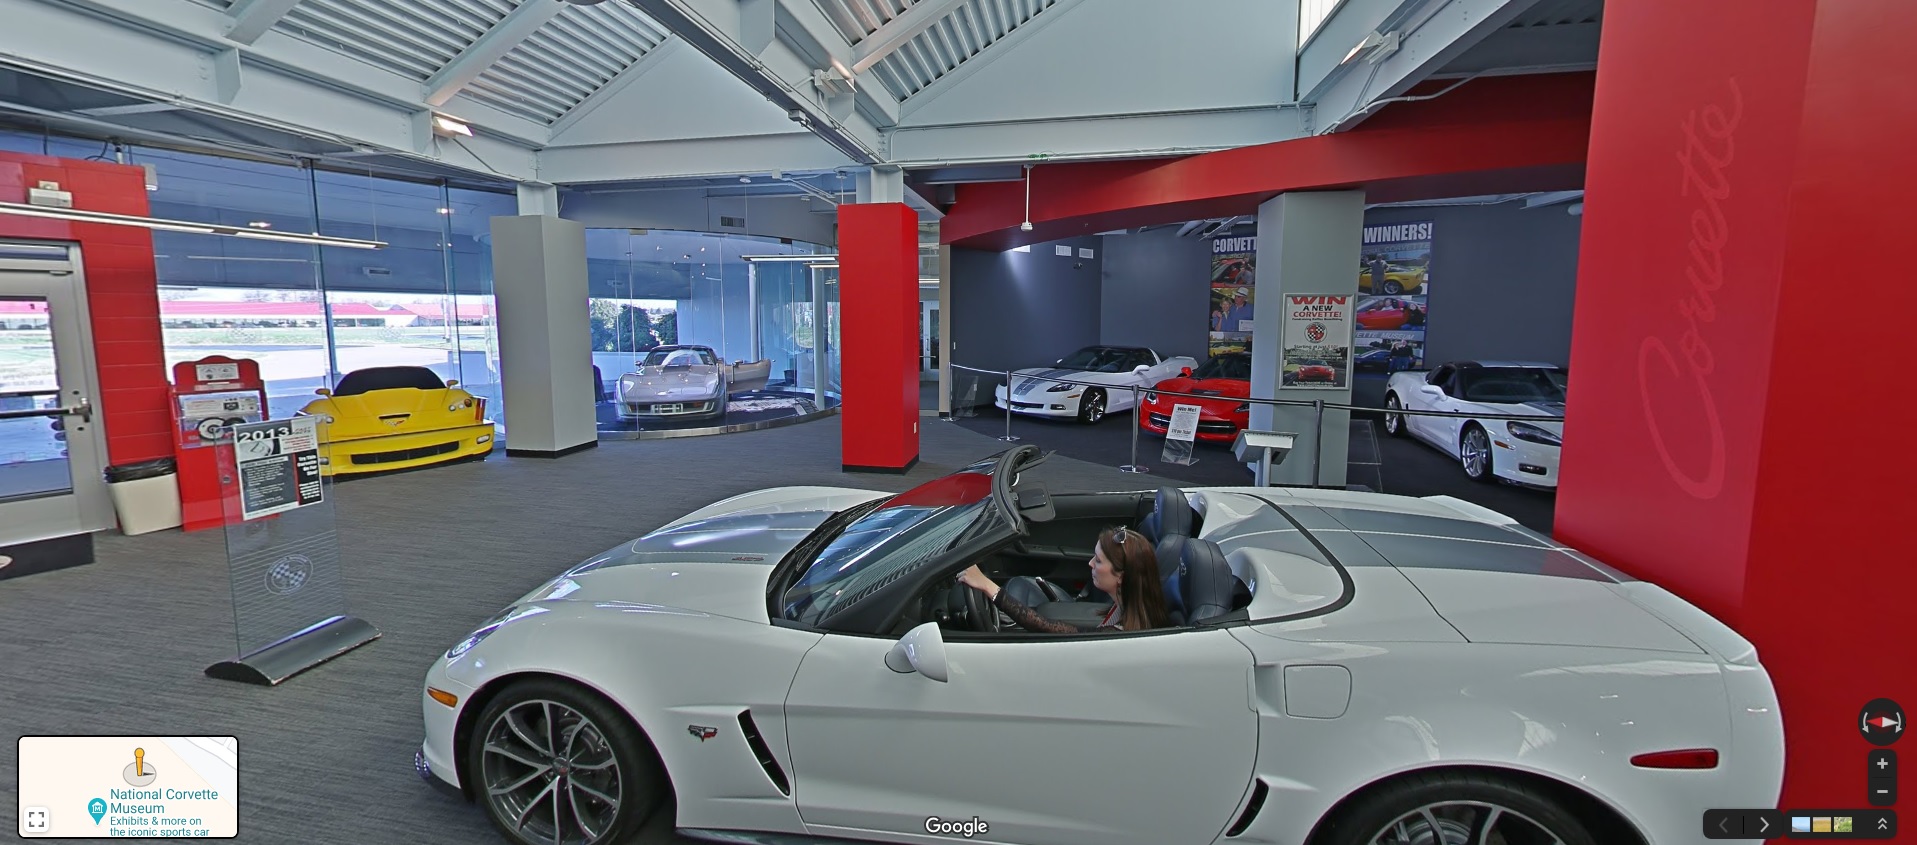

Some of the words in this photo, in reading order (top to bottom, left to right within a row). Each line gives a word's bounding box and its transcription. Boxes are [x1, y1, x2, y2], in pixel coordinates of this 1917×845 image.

[1363, 222, 1433, 244] WINNERS!
[1213, 236, 1257, 253] CORVETT
[1638, 76, 1744, 500] Corvette
[1291, 296, 1347, 305] WIN
[1380, 332, 1415, 340] MUSEUM
[238, 427, 290, 443] 2013
